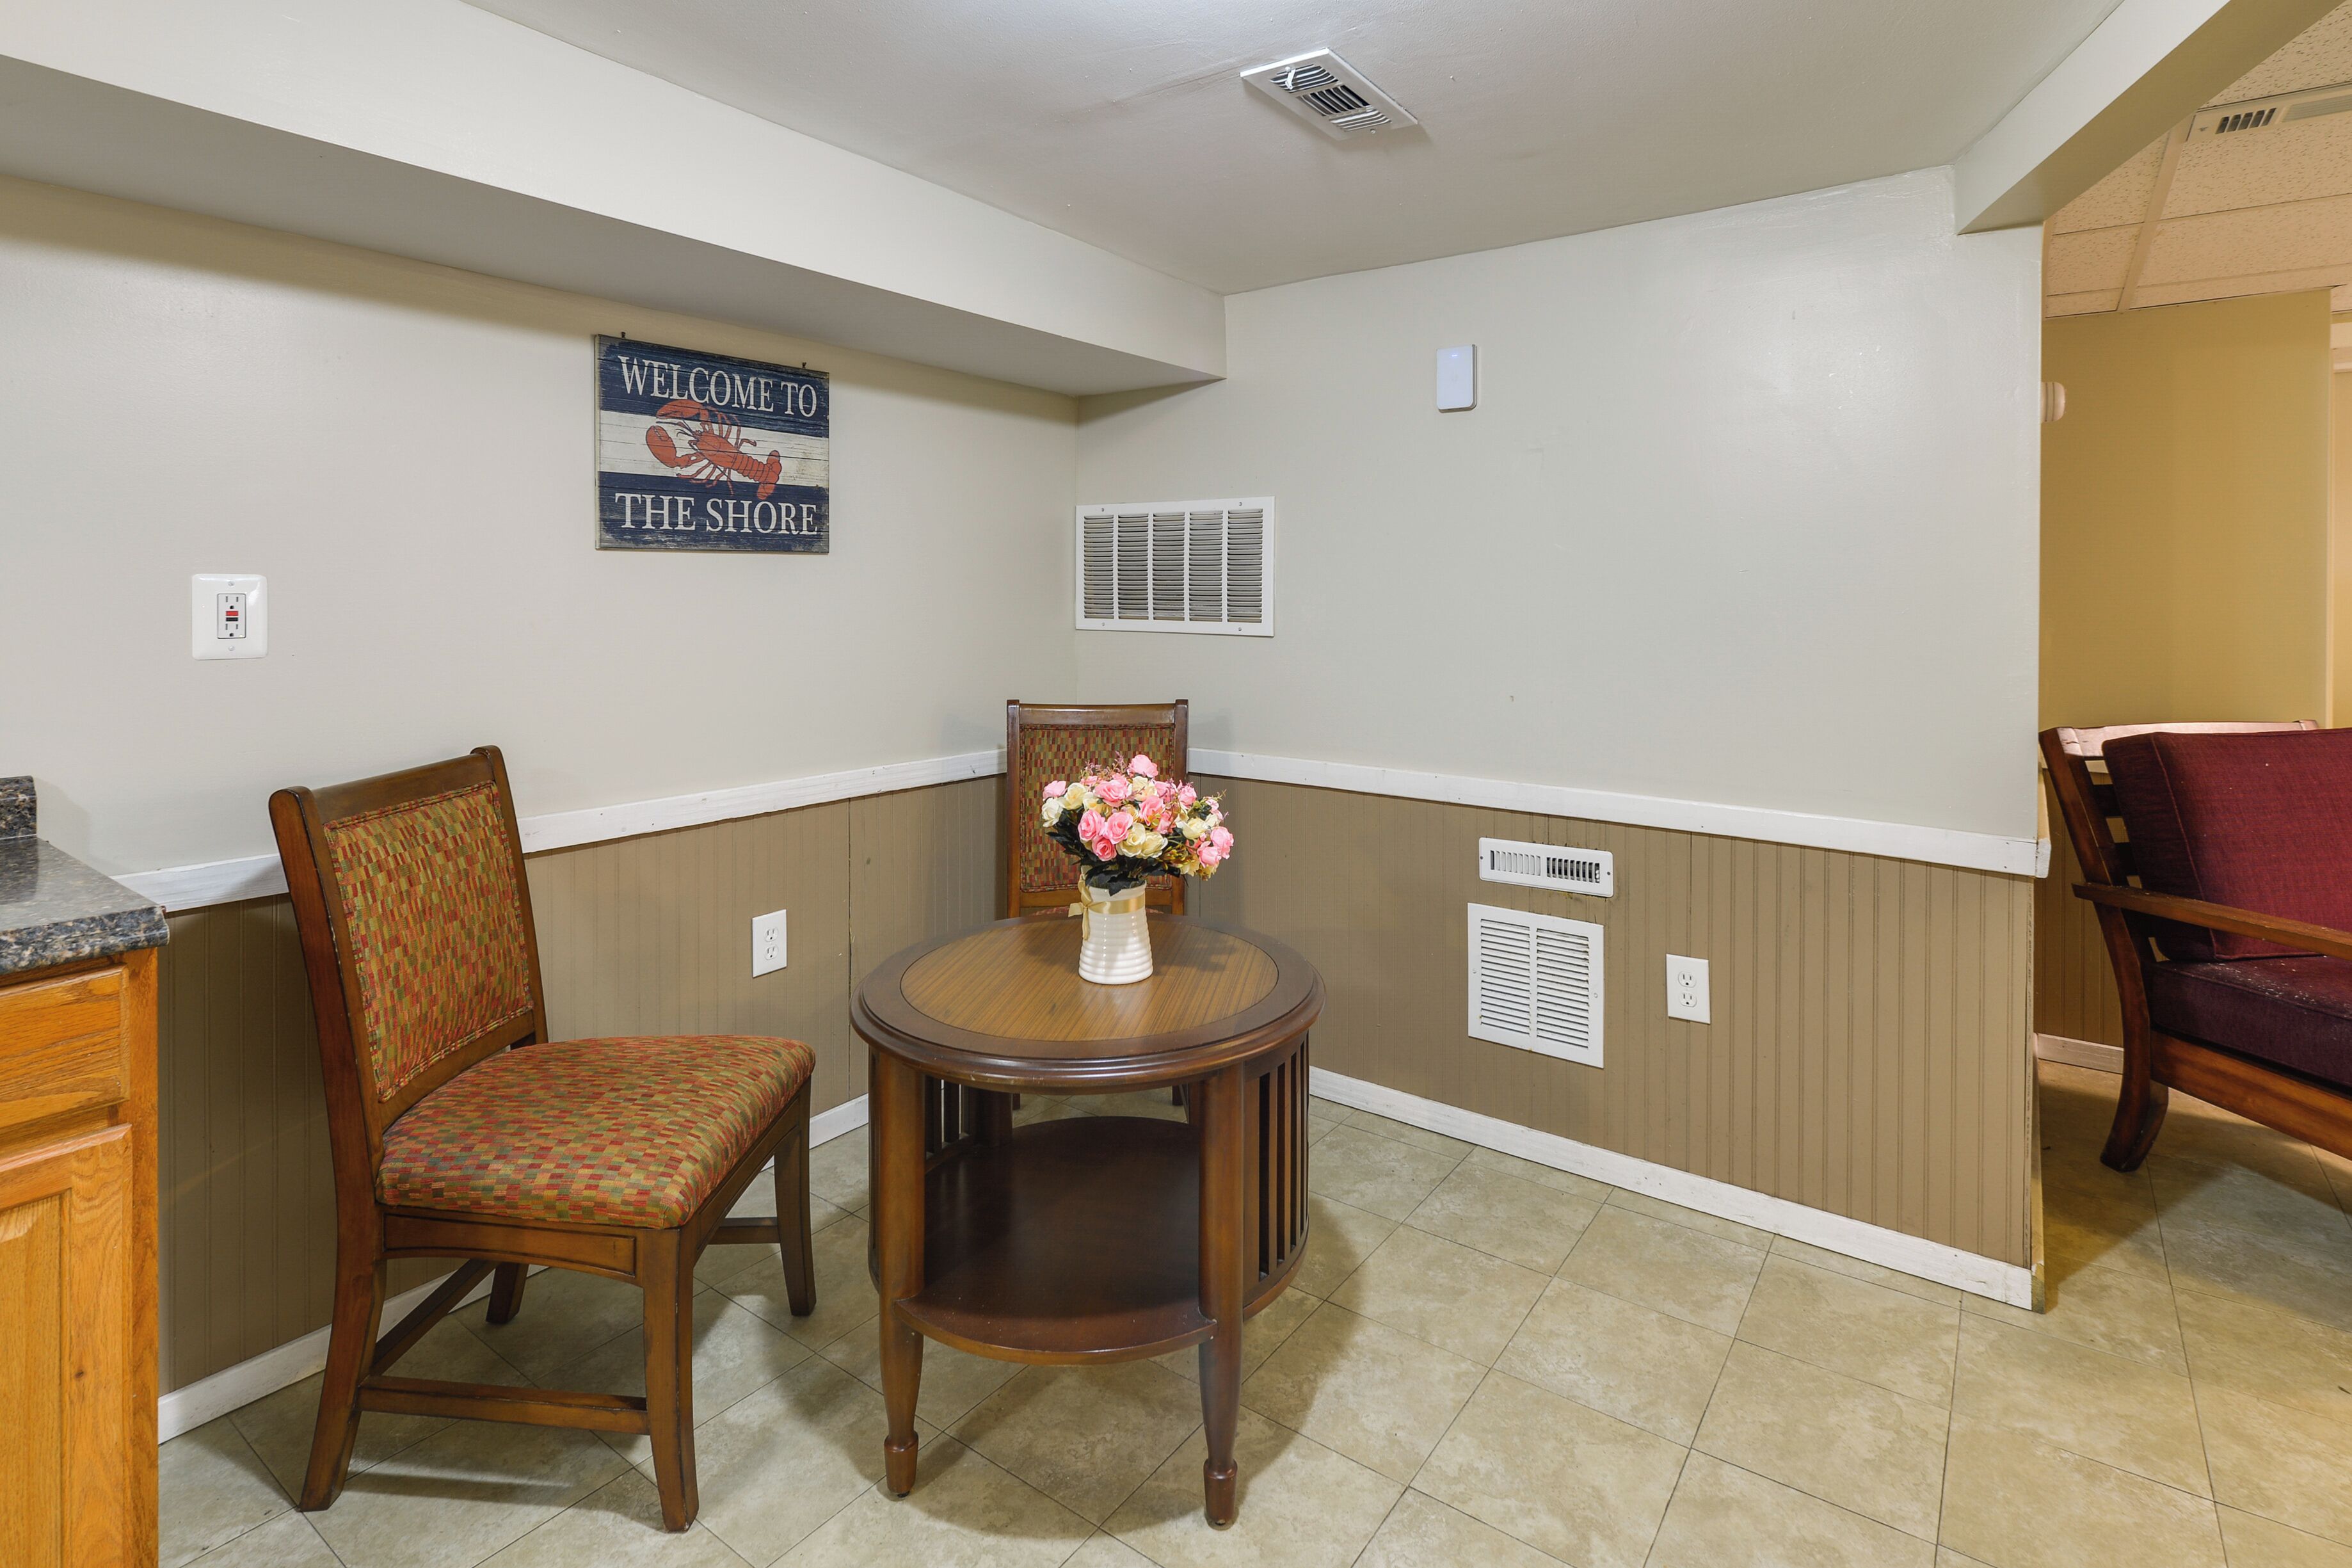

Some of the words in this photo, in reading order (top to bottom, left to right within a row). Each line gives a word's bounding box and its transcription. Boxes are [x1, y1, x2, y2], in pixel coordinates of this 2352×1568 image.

[618, 355, 774, 412] WELCOME
[781, 381, 817, 417] TO
[615, 492, 696, 531] THE
[706, 498, 817, 535] SHORE
